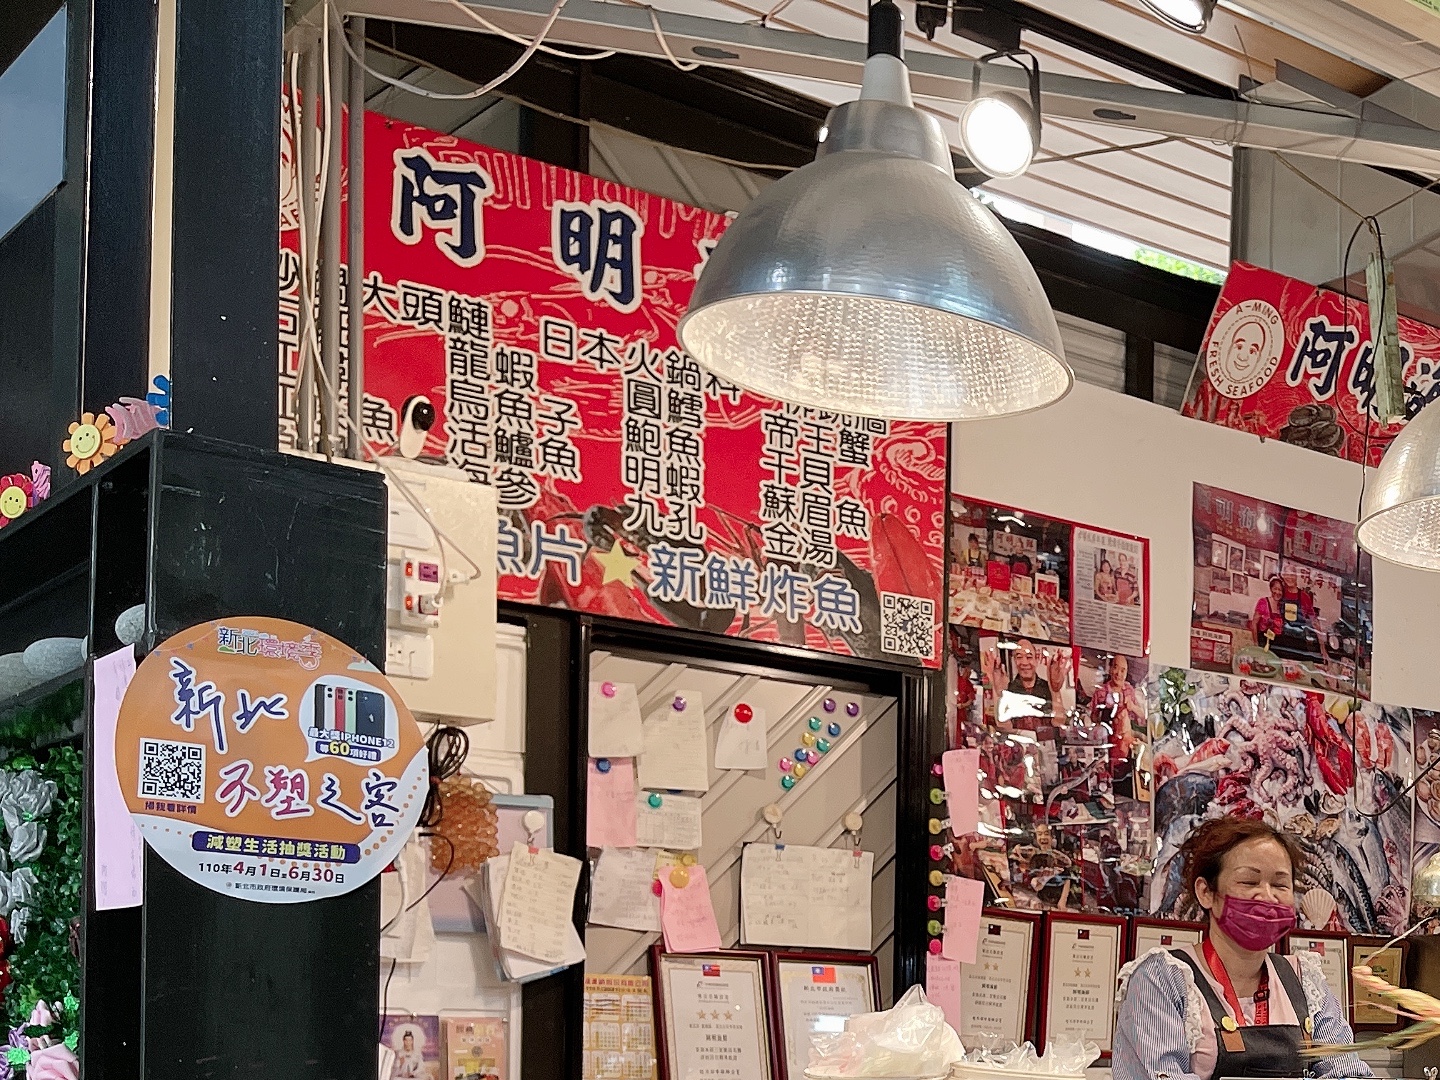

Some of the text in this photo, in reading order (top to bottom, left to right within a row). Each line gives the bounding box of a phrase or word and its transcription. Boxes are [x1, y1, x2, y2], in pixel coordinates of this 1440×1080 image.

[1235, 302, 1279, 327] A-MING
[1210, 341, 1279, 397] FRESH SEAFOOD
[652, 544, 862, 634] 新鮮炸魚
[169, 659, 288, 752] 新北
[218, 763, 400, 828] 不塑之客
[206, 833, 347, 861] 減塑生活抽獎活動
